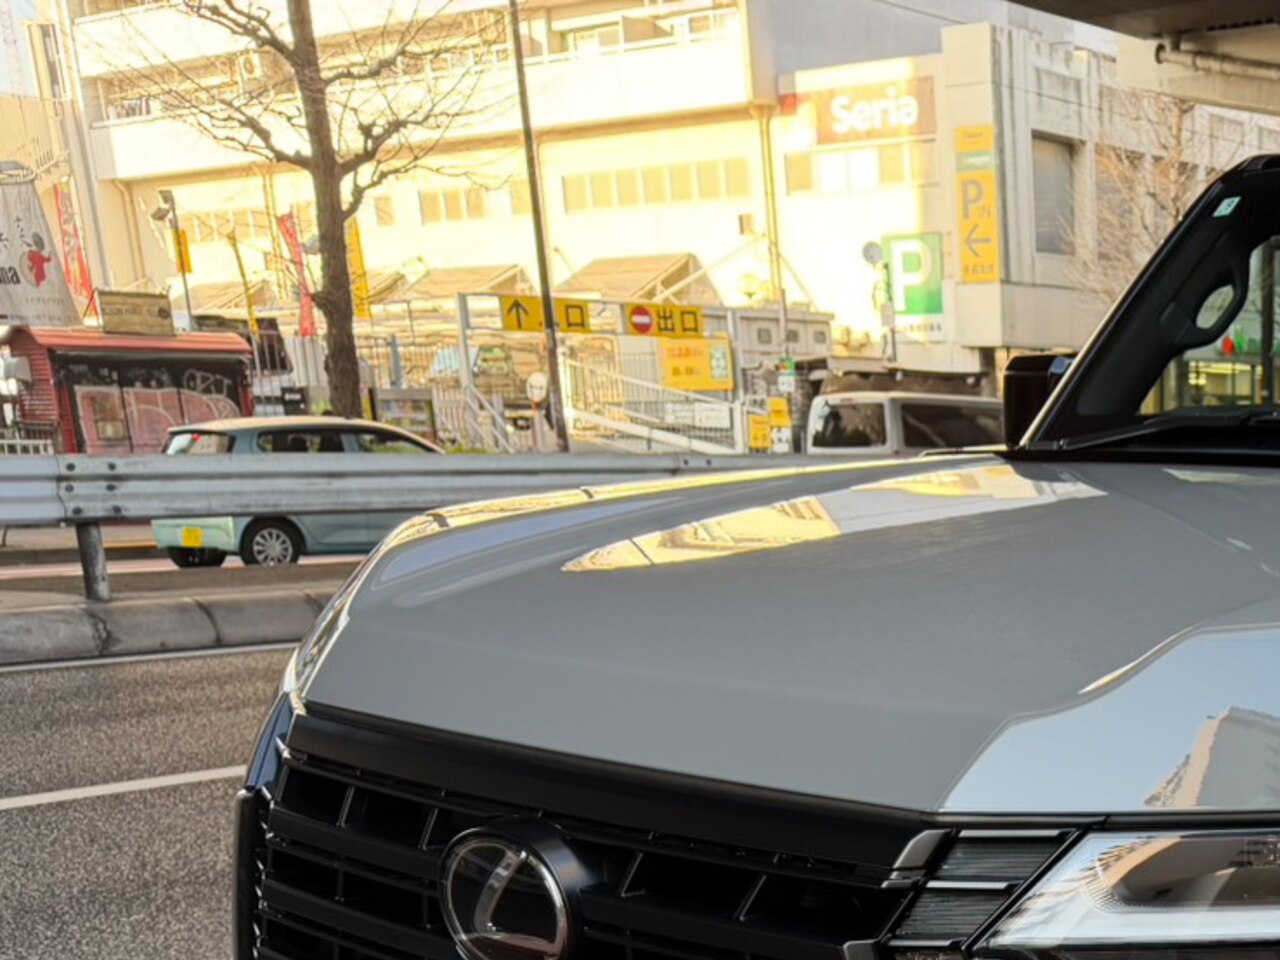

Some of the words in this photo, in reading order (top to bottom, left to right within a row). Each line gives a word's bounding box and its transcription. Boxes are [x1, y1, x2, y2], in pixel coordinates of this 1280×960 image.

[830, 86, 919, 133] Seria
[890, 239, 933, 311] P
[656, 307, 698, 333] 出口
